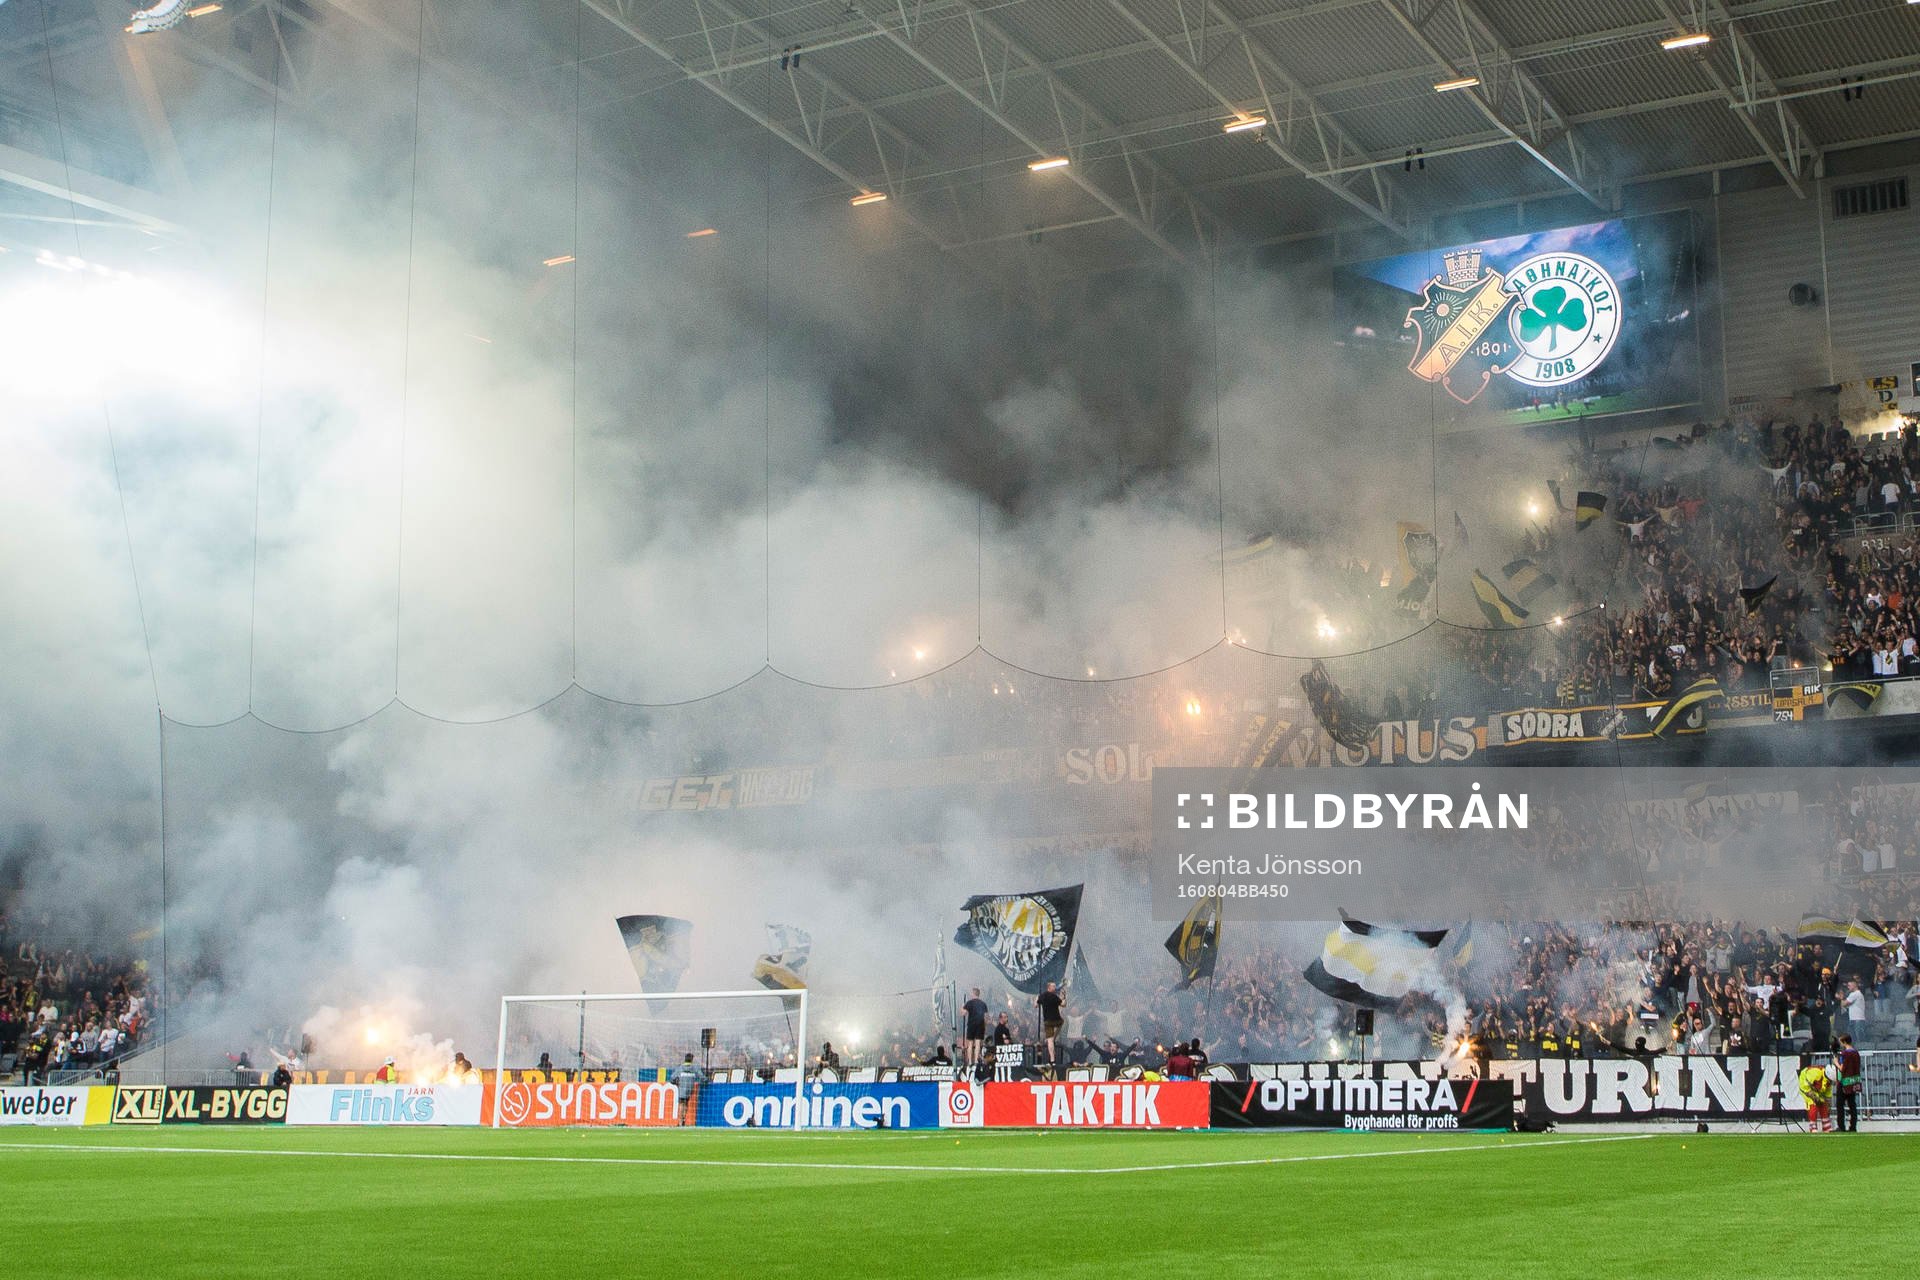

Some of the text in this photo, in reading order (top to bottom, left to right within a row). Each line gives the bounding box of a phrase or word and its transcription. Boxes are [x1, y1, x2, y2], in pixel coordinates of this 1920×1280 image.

[1509, 260, 1613, 314] ΑΘΗΝΑΪΚΟΣ
[1473, 342, 1510, 357] 1891
[1535, 358, 1576, 379] 1908
[1804, 684, 1821, 695] AIK
[1775, 710, 1793, 722] 754
[2, 1089, 78, 1115] weber
[116, 1089, 160, 1118] XL
[166, 1088, 288, 1119] XL-BYGG
[330, 1088, 435, 1122] Flinks
[536, 1082, 679, 1120] SYNSAM
[723, 1083, 911, 1129] onninen
[1031, 1084, 1161, 1125] TAKTIK
[1261, 1079, 1458, 1111] OPTIMERA
[1344, 1113, 1459, 1131] Bygghandel för proffs
